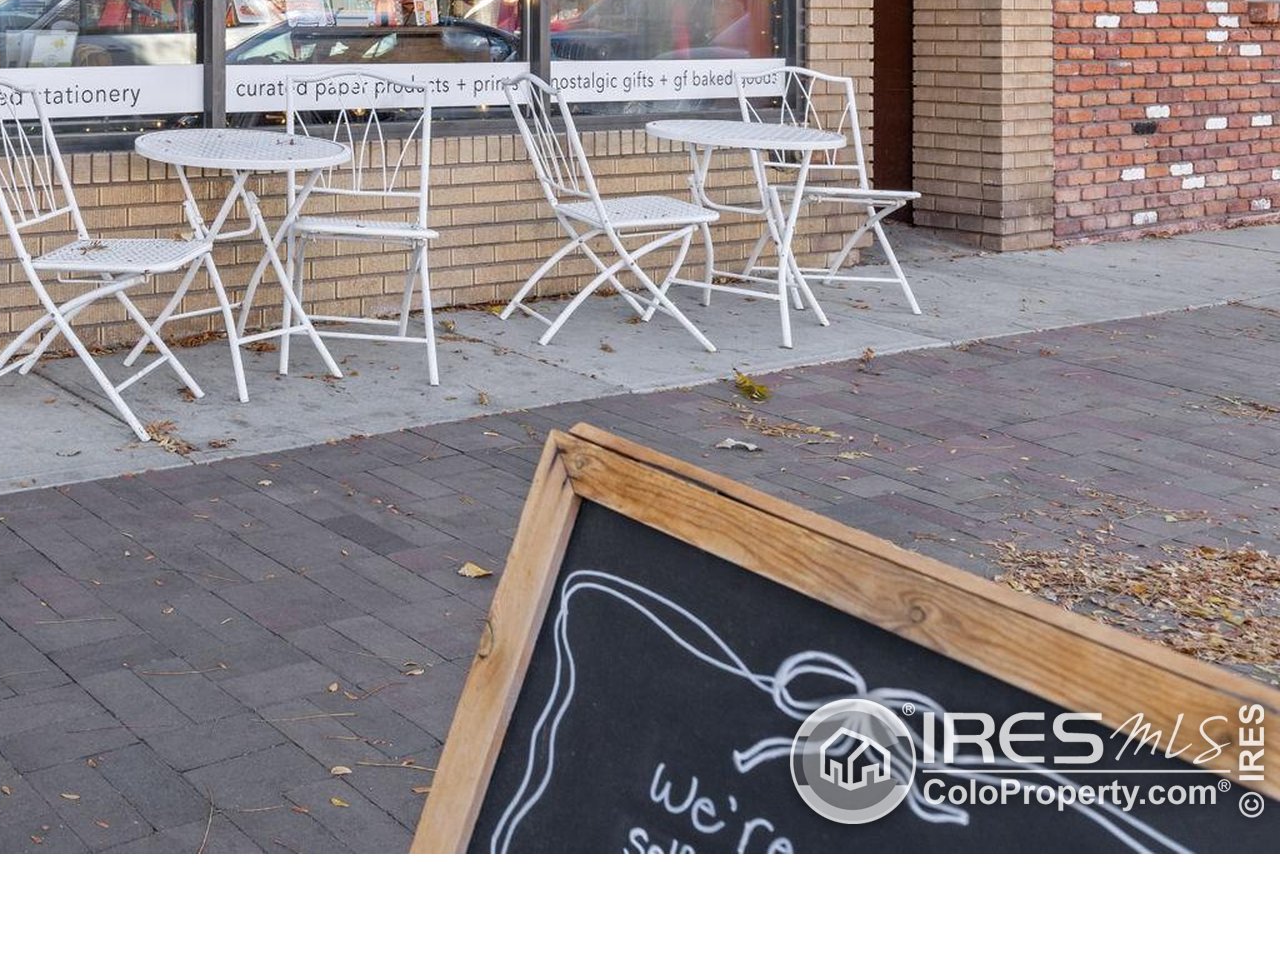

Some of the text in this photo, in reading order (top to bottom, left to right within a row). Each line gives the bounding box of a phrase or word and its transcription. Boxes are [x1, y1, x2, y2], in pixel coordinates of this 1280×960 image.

[235, 80, 308, 97] curatd
[316, 80, 368, 102] paper
[623, 71, 654, 92] gifts
[673, 71, 688, 91] gf
[692, 69, 733, 87] baked
[38, 84, 141, 107] tationery
